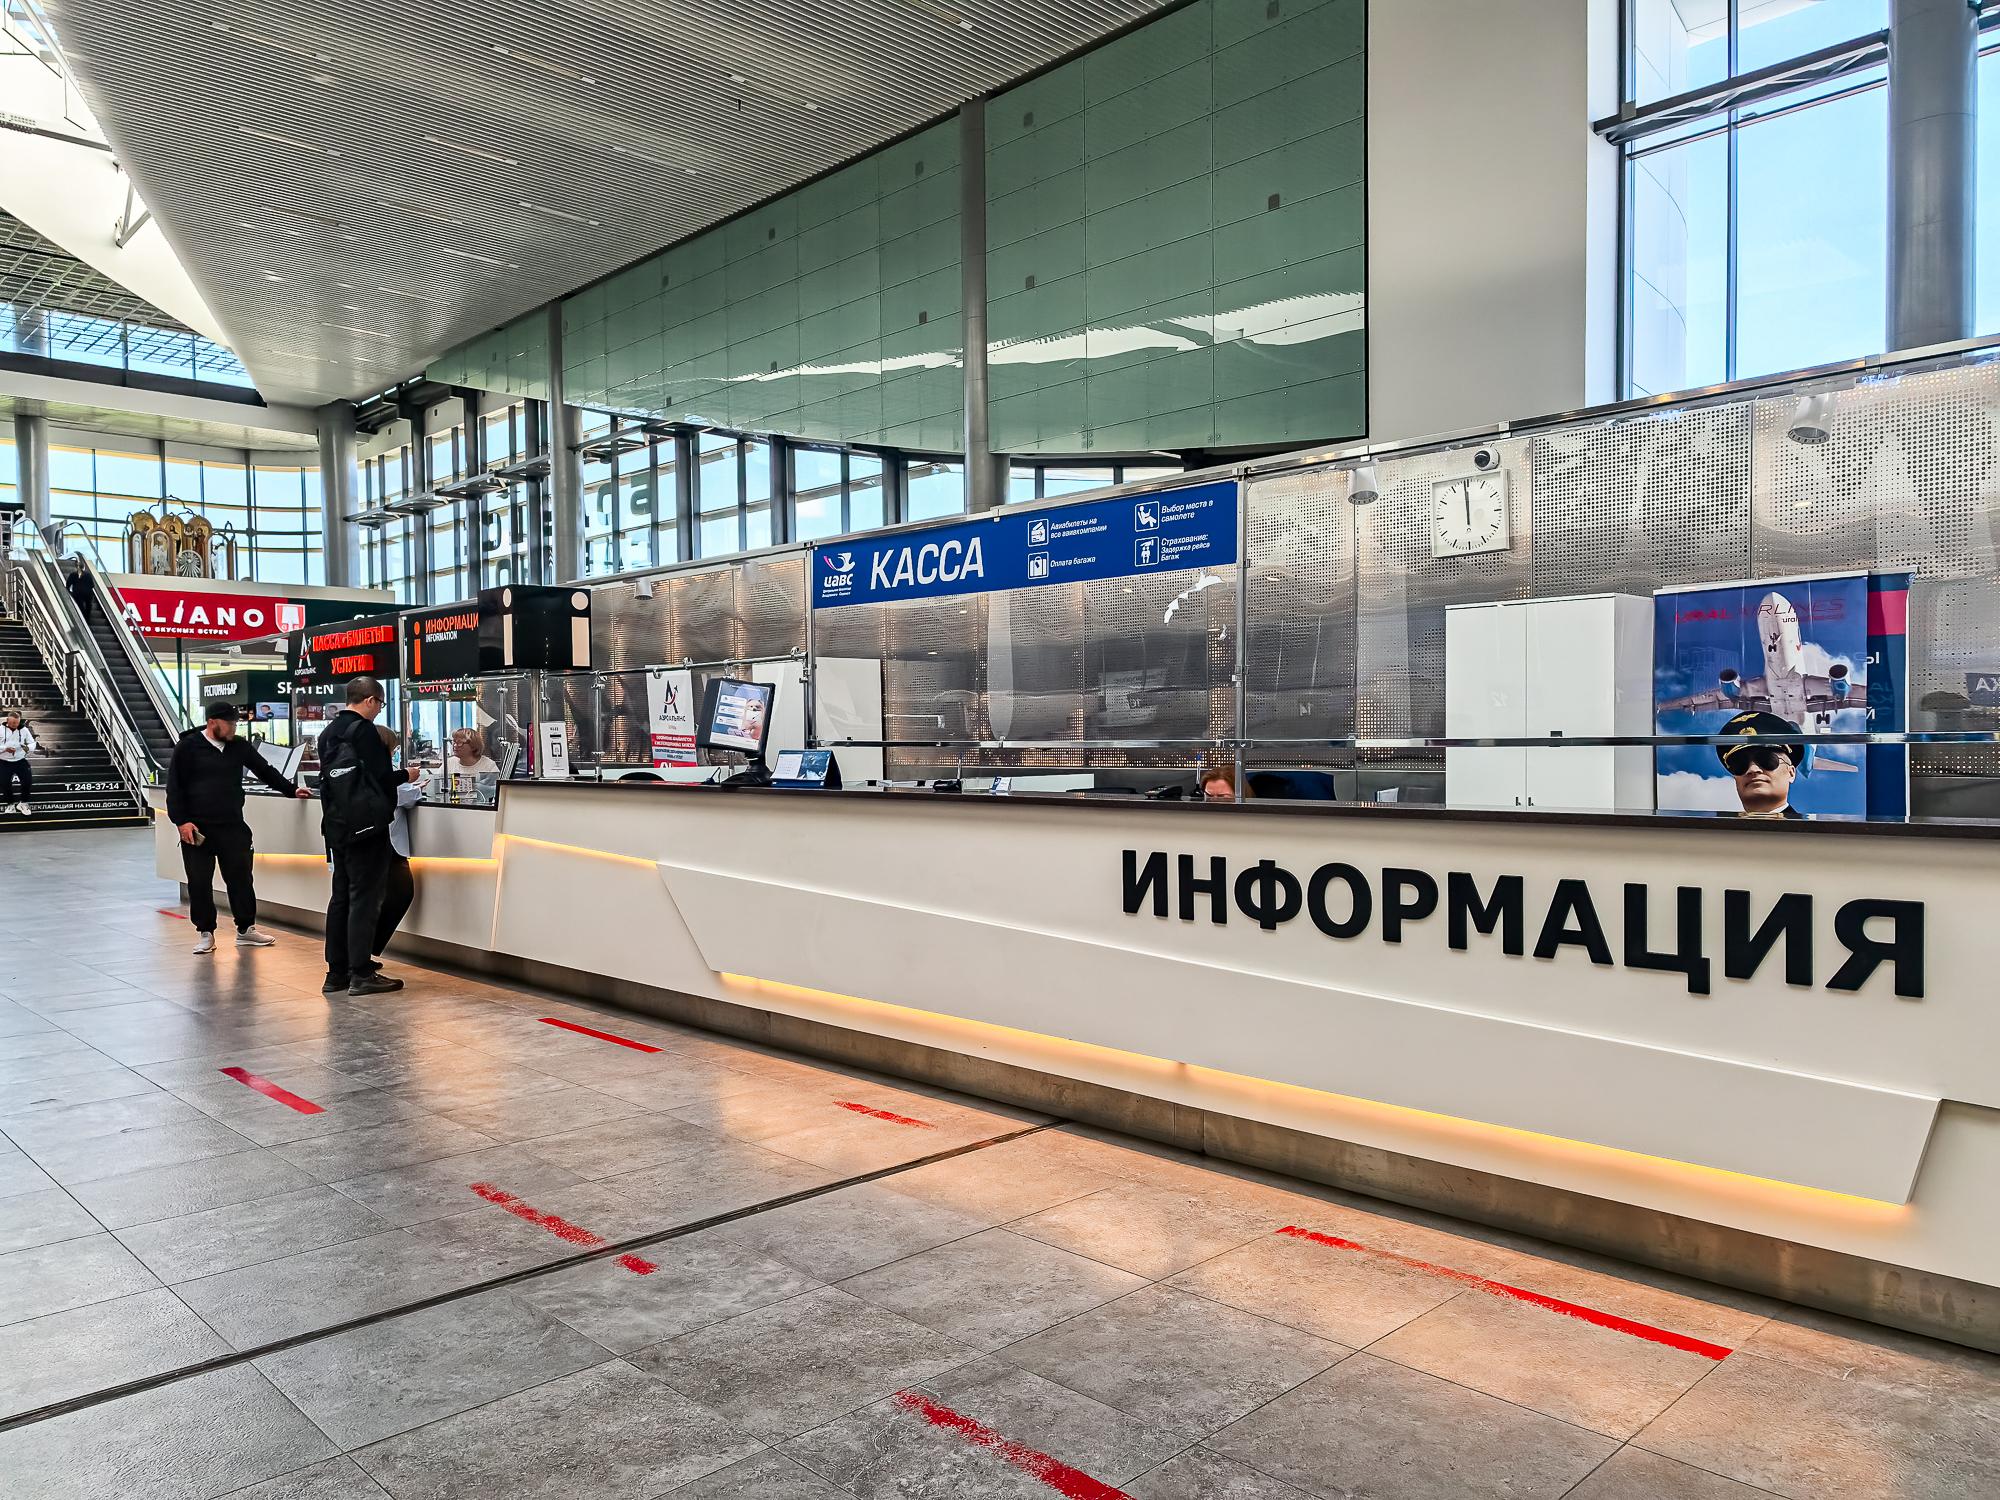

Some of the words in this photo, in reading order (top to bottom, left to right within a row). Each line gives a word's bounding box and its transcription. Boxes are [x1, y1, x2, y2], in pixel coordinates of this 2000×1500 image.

[1161, 504, 1185, 515] Выбор
[1185, 500, 1207, 510] места
[1050, 519, 1088, 531] Авиабилеты
[1089, 517, 1098, 525] на
[1161, 512, 1195, 523] самолете
[1050, 531, 1061, 539] все
[1062, 525, 1107, 538] авиакомпании
[1161, 533, 1209, 547] Страхование:
[1160, 544, 1191, 555] Задержка
[1191, 541, 1211, 551] рейса
[870, 537, 984, 590] КАССА
[1050, 559, 1073, 568] Оплата
[1073, 556, 1096, 565] багажа
[1160, 554, 1180, 562] Багаж
[425, 612, 479, 634] ИНФОРМАЦИ
[346, 626, 387, 647] БИЛЕТЫ
[425, 630, 458, 643] INFORMATION
[331, 654, 370, 675] УСЛУГИ
[203, 682, 238, 697] РЕСТОРАН-БАР
[75, 782, 119, 791] 248-37-14
[1121, 849, 1924, 998] ИНФОРМАЦИЯ
